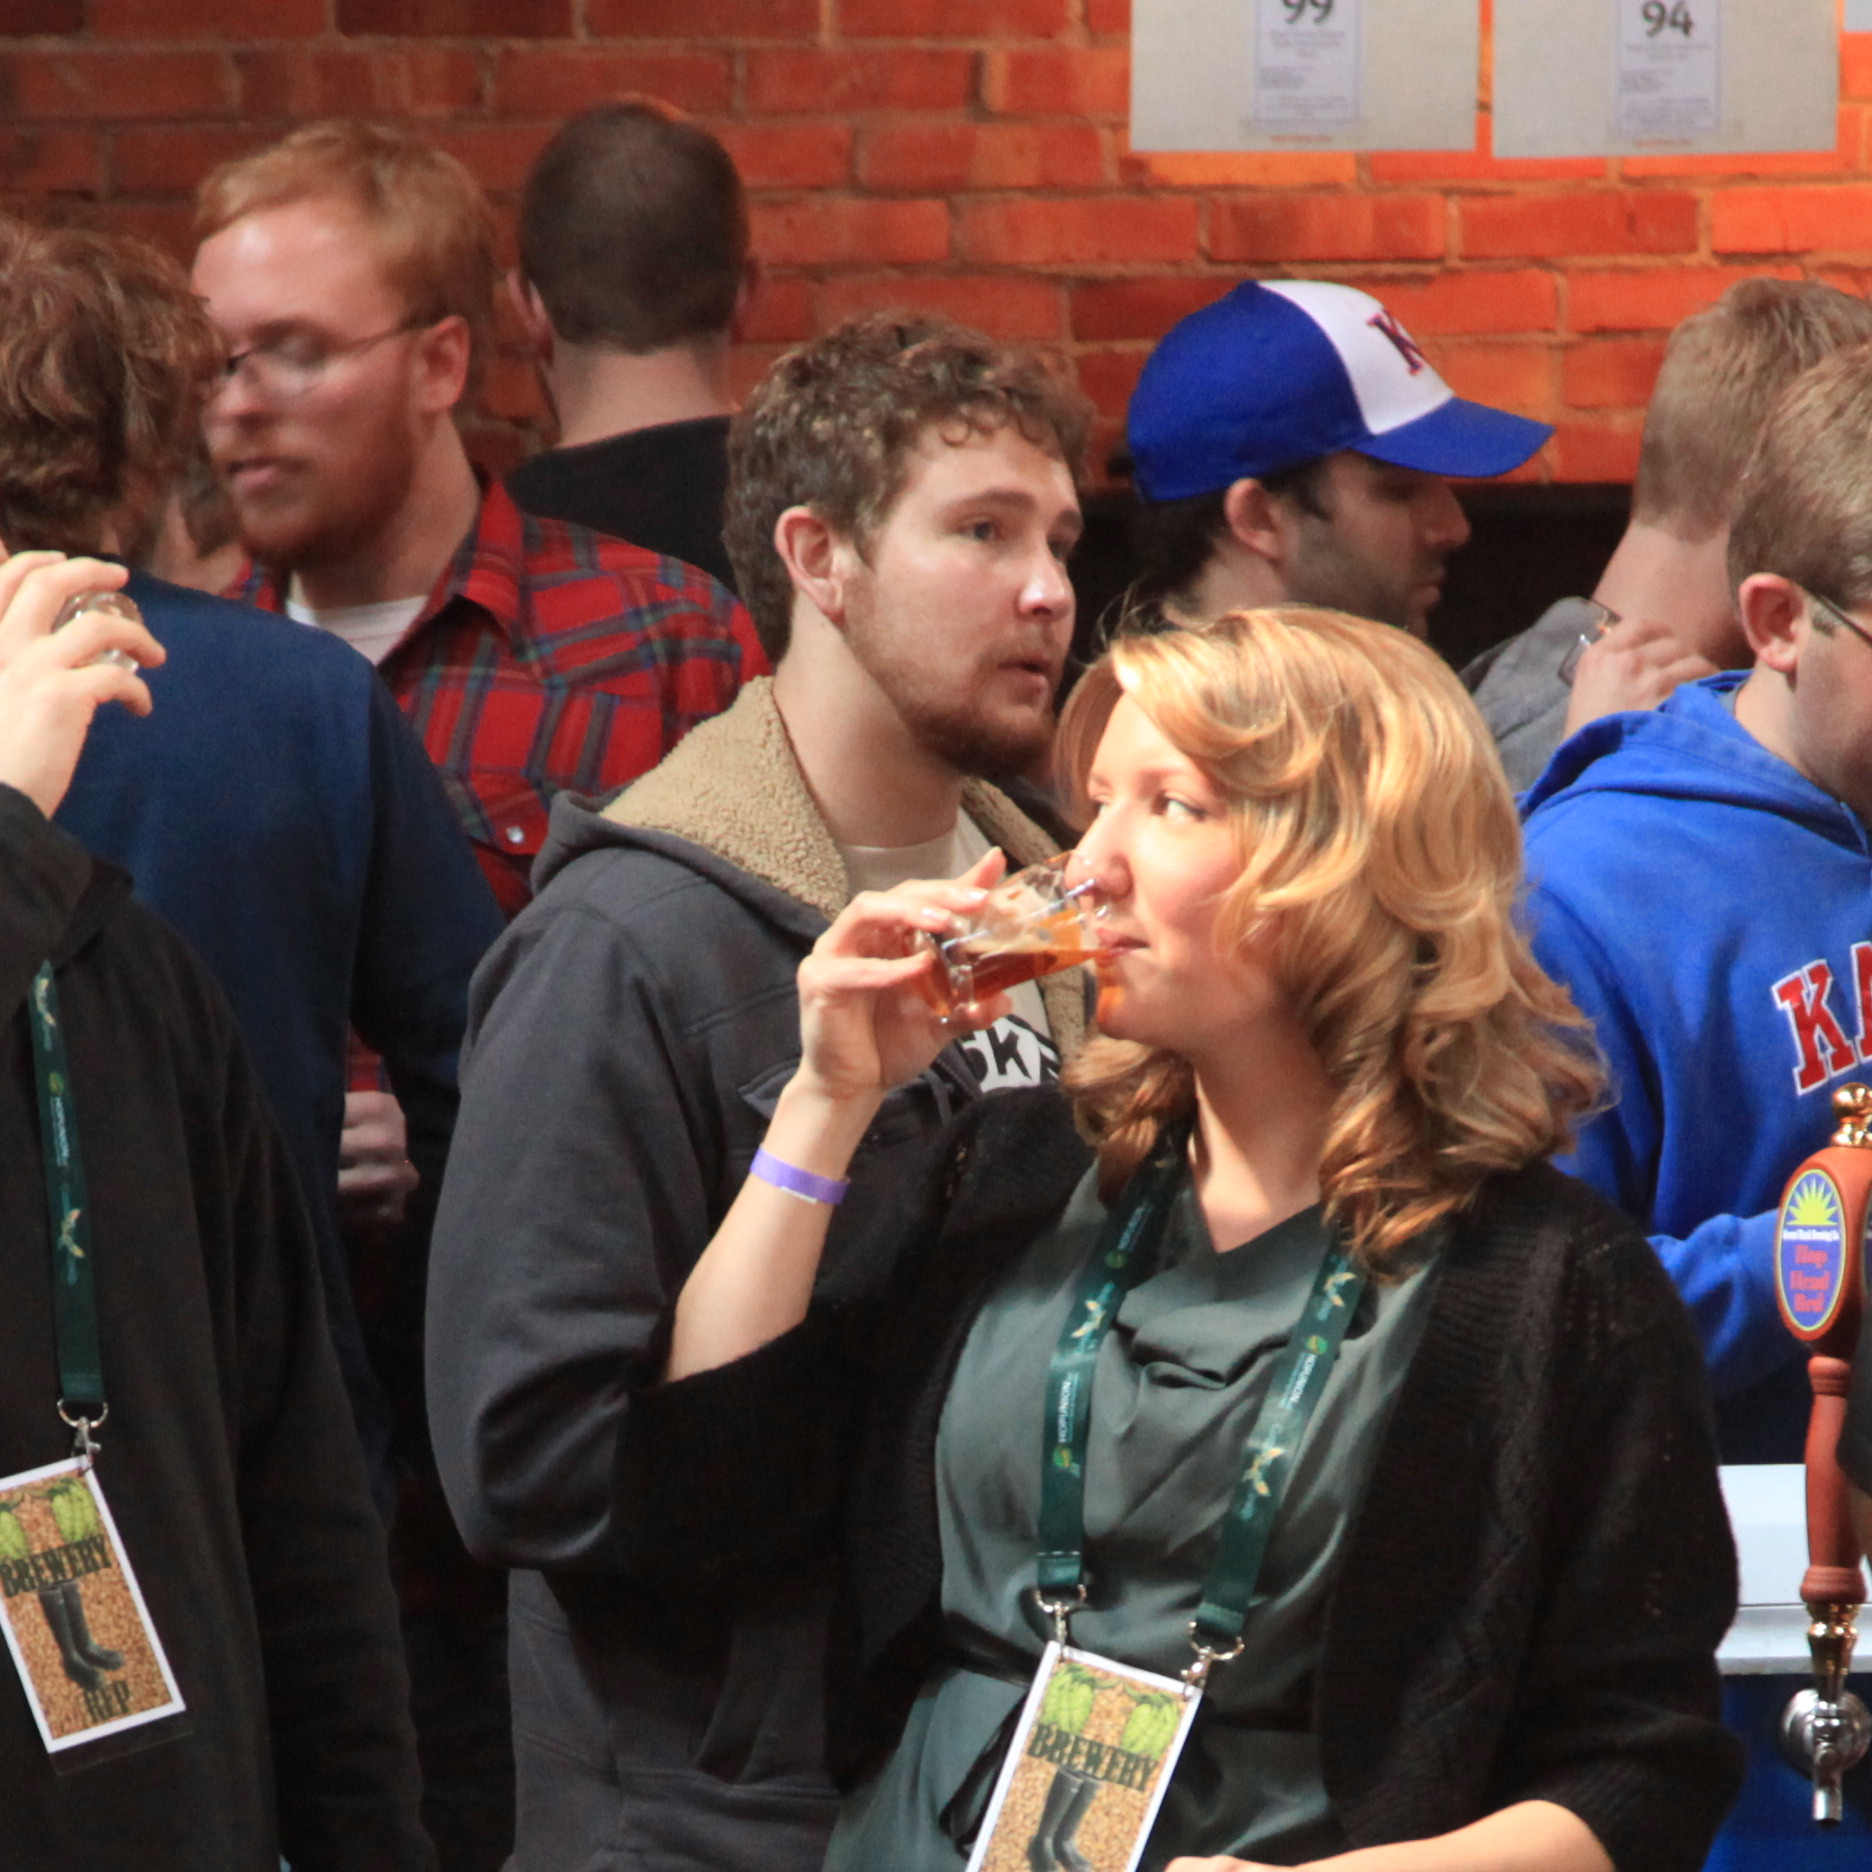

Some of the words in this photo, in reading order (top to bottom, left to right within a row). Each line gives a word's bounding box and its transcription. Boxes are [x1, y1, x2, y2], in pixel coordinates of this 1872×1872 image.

[1642, 0, 1694, 38] 94
[81, 1679, 132, 1724] REP
[1025, 1723, 1161, 1794] BREWERY
